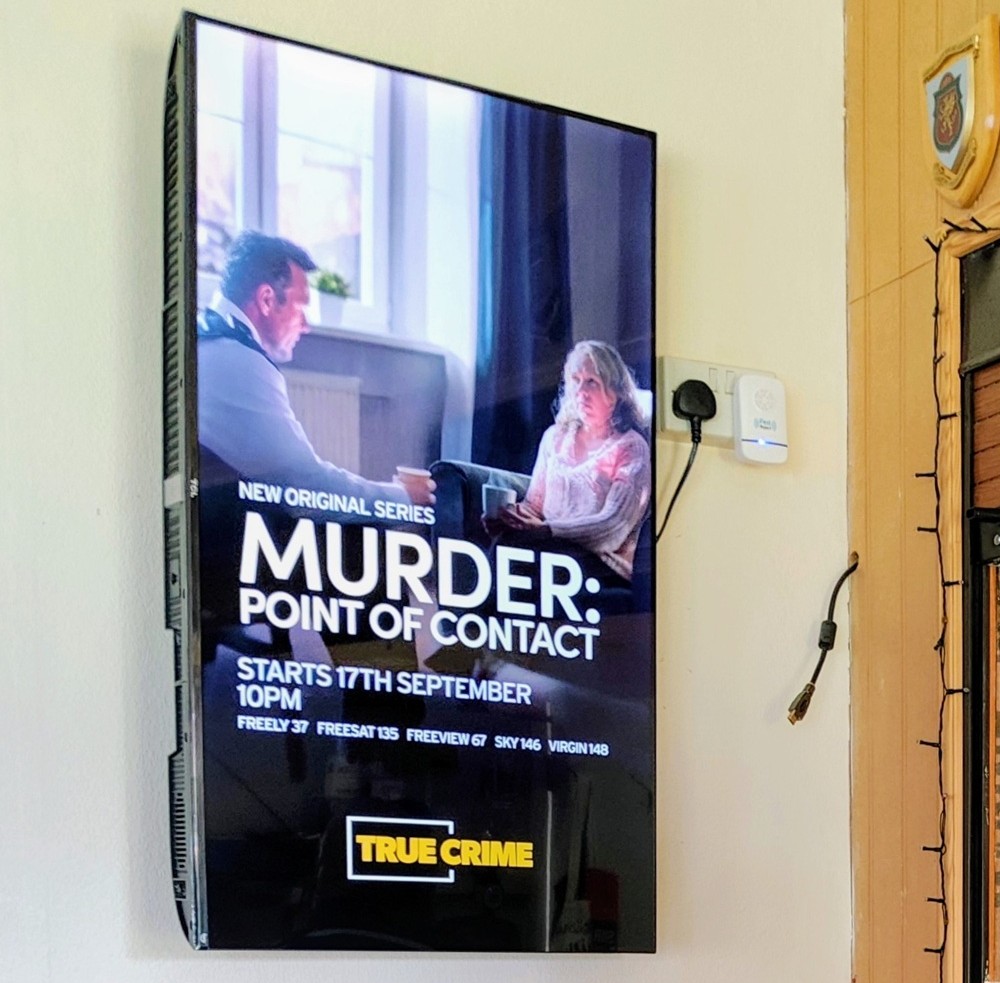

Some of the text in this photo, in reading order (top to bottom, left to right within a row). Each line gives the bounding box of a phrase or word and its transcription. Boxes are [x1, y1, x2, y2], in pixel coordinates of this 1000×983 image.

[238, 481, 436, 525] NEW ORIGINAL SERIES
[239, 511, 600, 624] MURDER:
[239, 587, 600, 660] POINT OF CONTACT
[236, 683, 302, 711] 10PM
[237, 656, 532, 705] STARTS 17TH SEPTEMBER
[237, 715, 609, 757] FREELY 37 FREESAT 135 FREEVIEW 67 SKY 146 VIRGIN 148
[355, 835, 534, 868] TRUE CRIME
